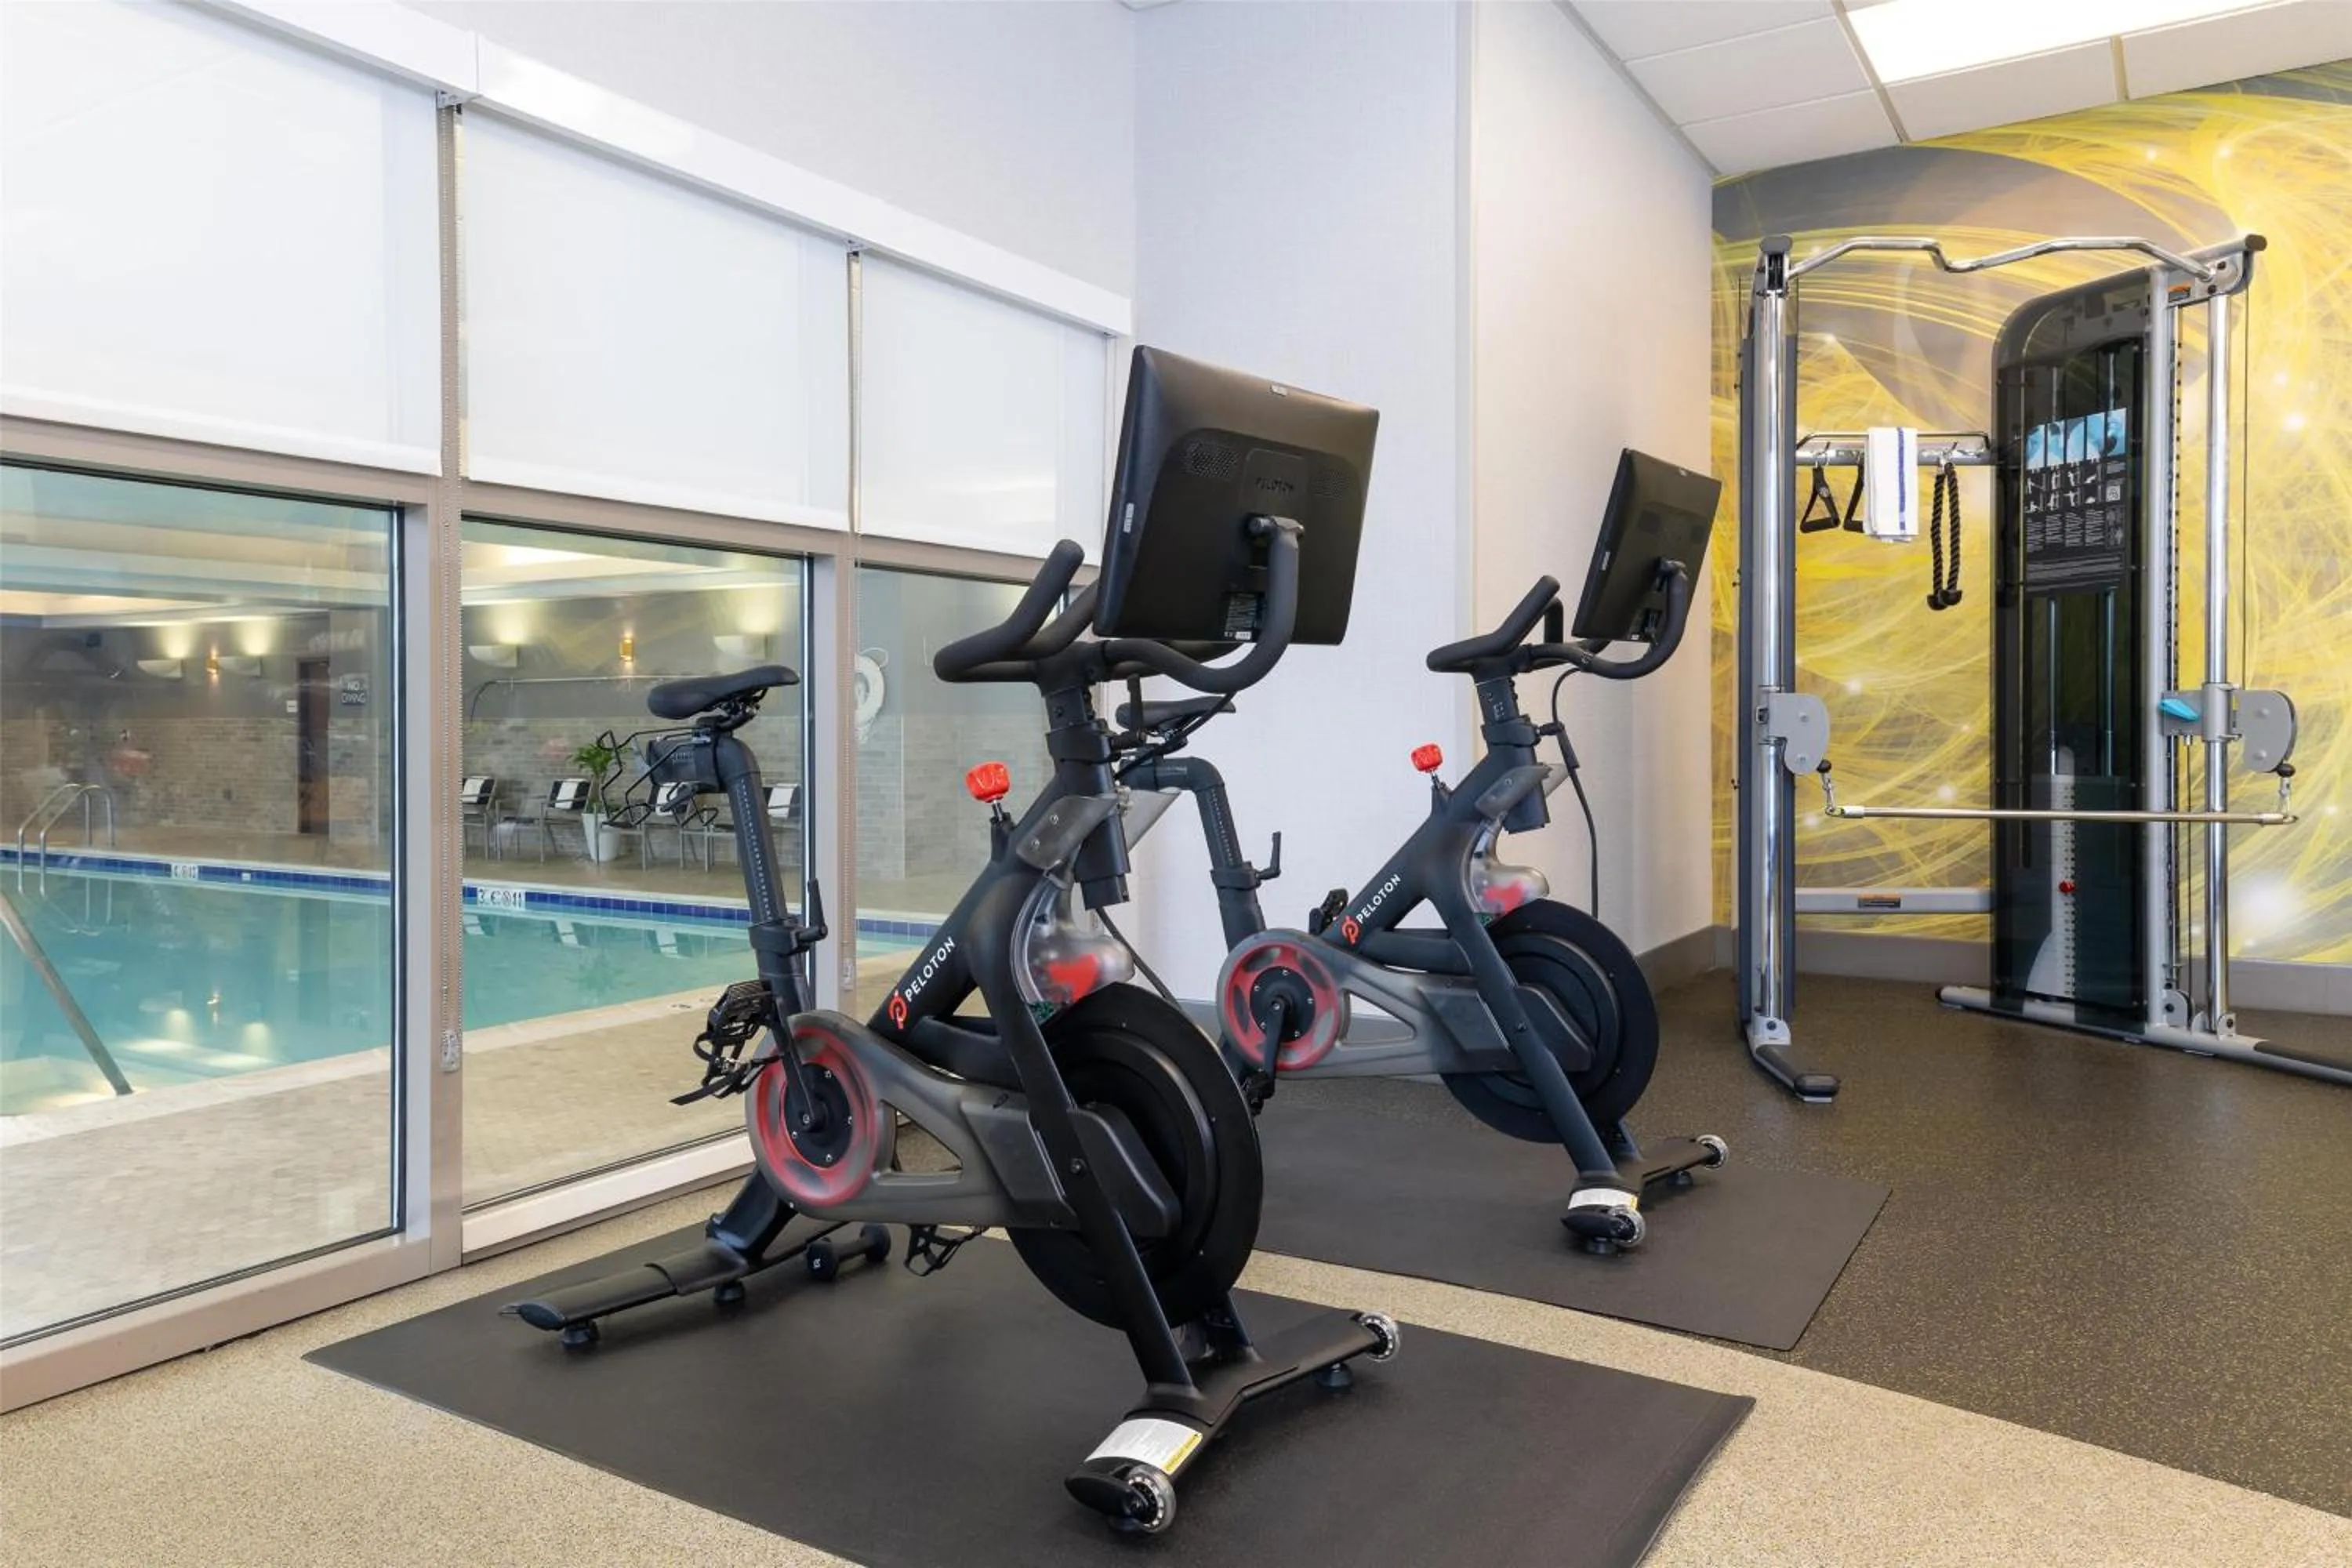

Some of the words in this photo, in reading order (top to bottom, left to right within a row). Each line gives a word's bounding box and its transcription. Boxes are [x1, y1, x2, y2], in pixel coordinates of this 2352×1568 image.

[347, 681, 360, 691] NO
[1356, 873, 1401, 924] PELOTON
[904, 936, 956, 1002] PELOTON
